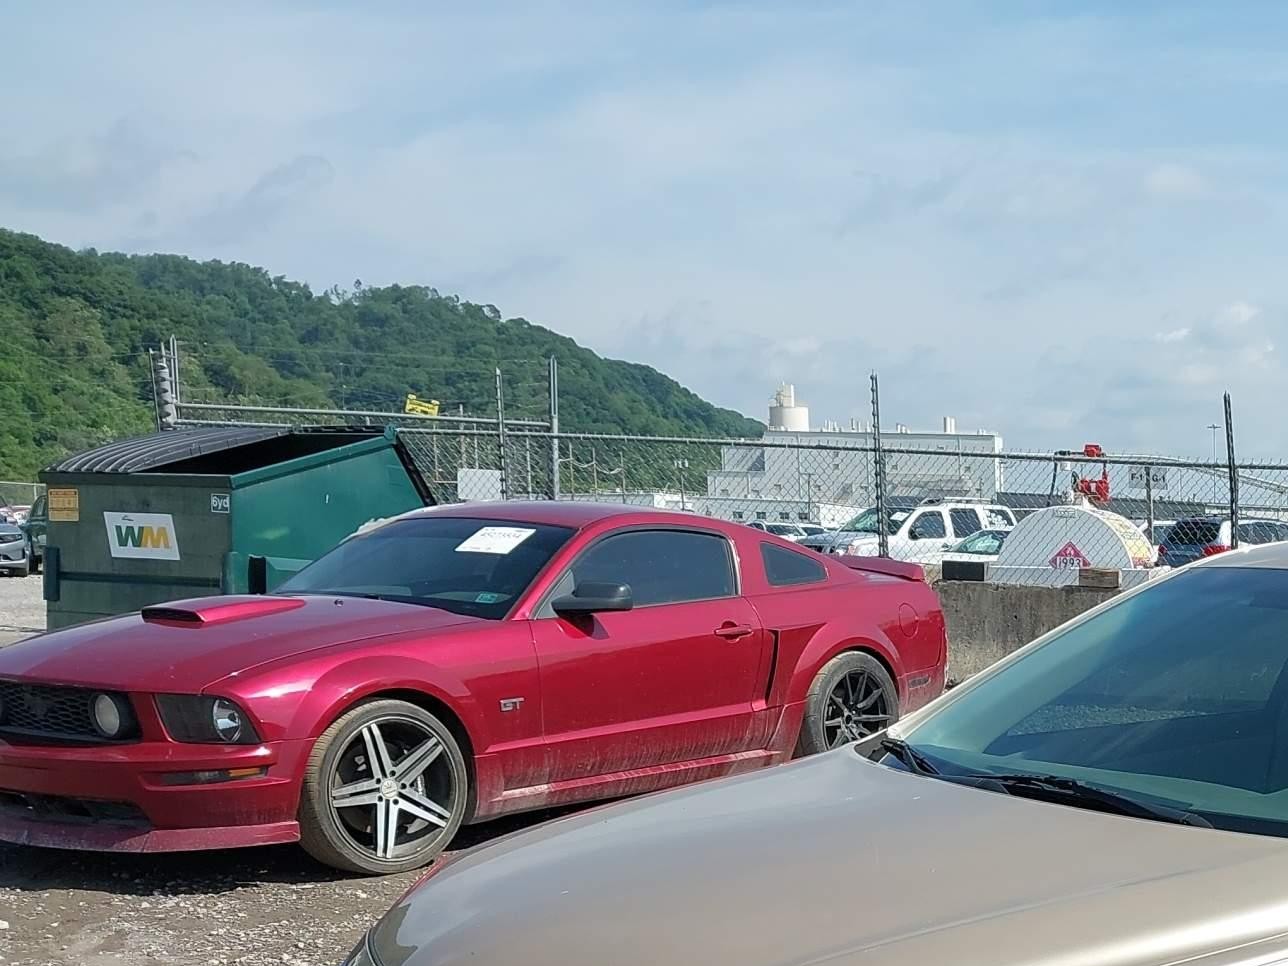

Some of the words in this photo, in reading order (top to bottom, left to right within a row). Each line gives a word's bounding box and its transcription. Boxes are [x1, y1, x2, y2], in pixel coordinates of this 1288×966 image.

[212, 496, 230, 509] 6yd
[115, 525, 170, 549] WM
[499, 697, 525, 711] GT
